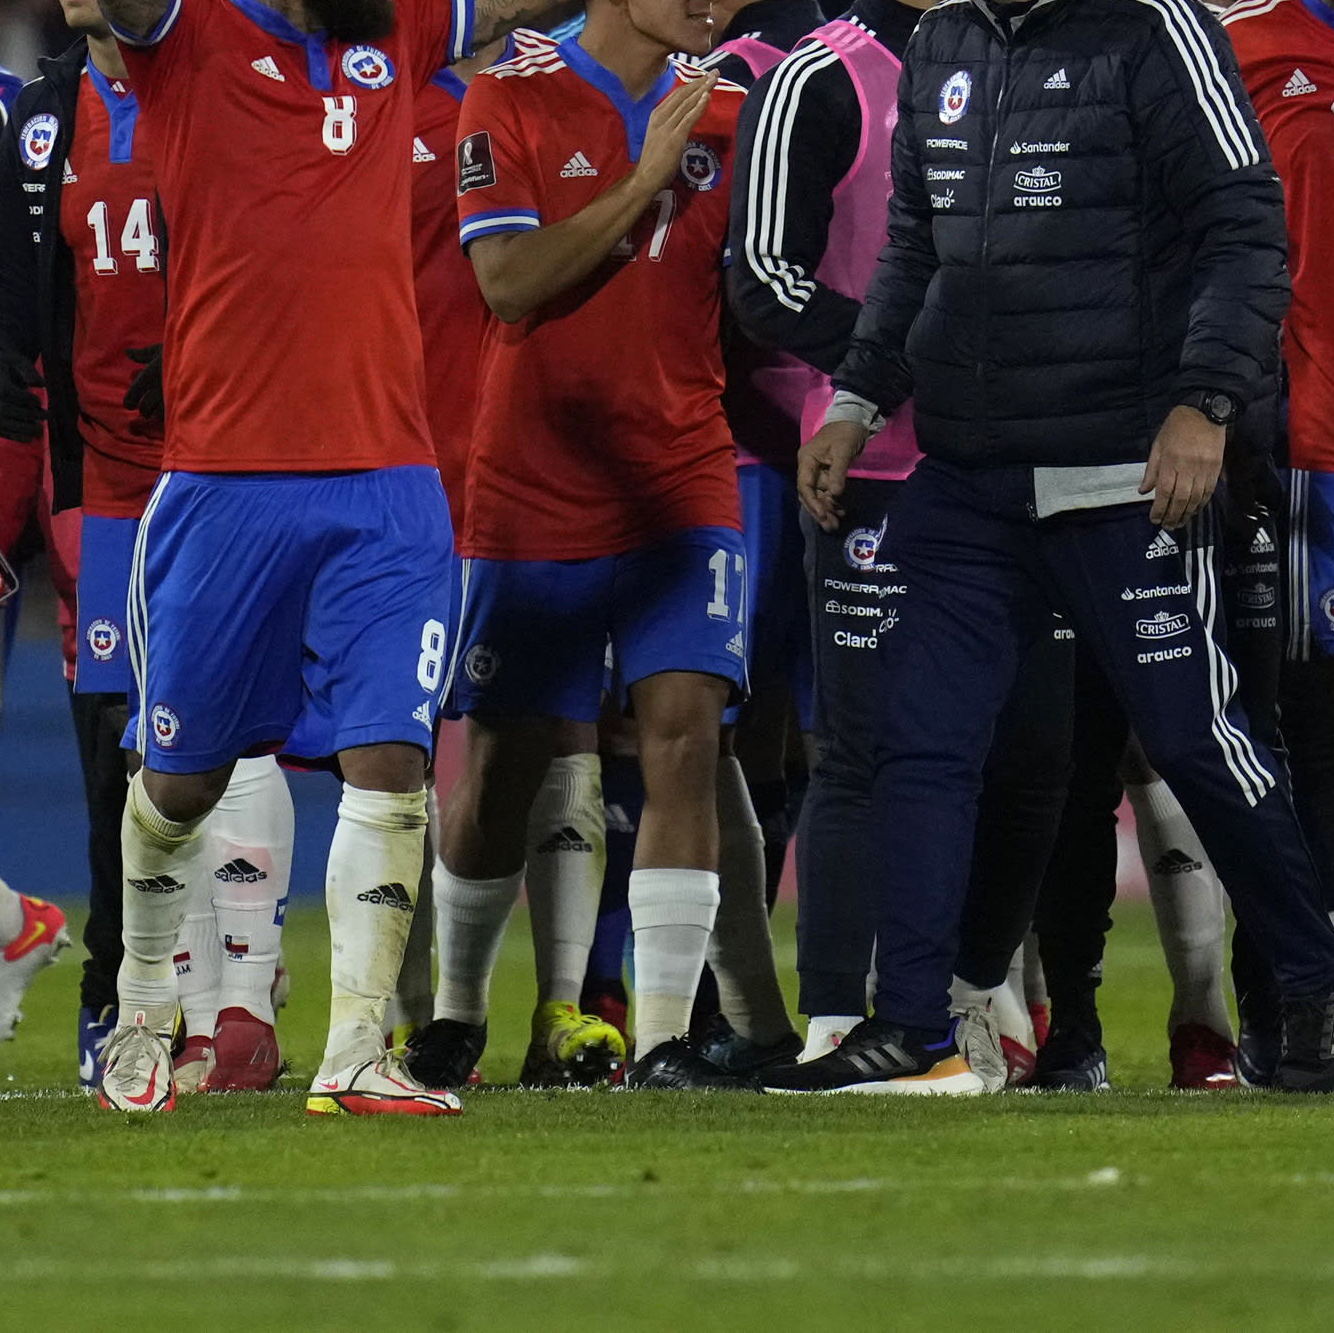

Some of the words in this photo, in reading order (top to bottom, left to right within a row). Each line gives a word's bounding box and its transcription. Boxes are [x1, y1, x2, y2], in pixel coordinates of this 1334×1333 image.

[1044, 80, 1070, 90] adidas
[1282, 83, 1317, 98] adidas
[322, 95, 357, 156] 8
[926, 138, 968, 151] POWERADE
[1021, 141, 1071, 154] Santander
[560, 167, 598, 179] adidas
[933, 169, 966, 181] SODIMAC
[1017, 174, 1058, 189] CRISTAL
[1013, 195, 1063, 207] arauco
[87, 198, 159, 276] 14
[824, 578, 879, 595] POWERA
[1135, 584, 1192, 600] Santander
[841, 604, 883, 618] SODIM
[1140, 618, 1186, 635] CRISTAL
[416, 618, 446, 695] 8
[1137, 645, 1193, 664] arauco
[214, 870, 268, 884] adidas
